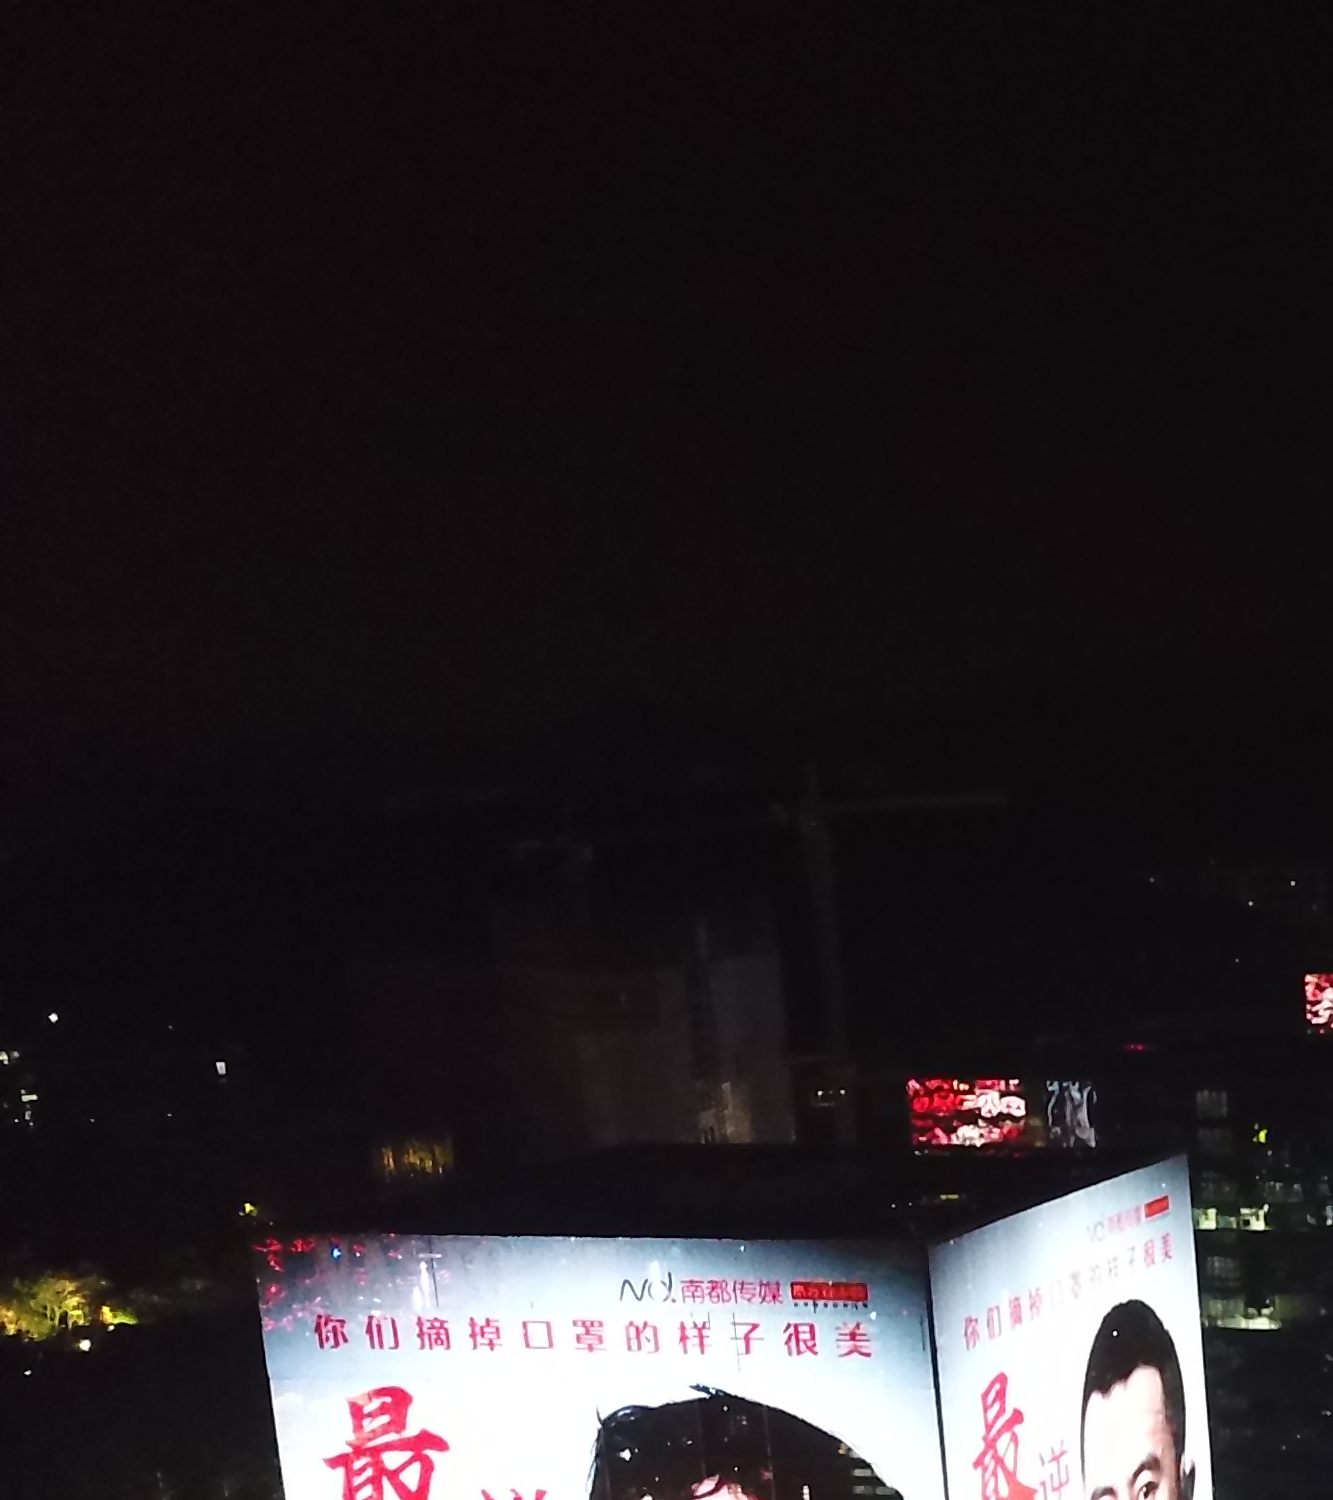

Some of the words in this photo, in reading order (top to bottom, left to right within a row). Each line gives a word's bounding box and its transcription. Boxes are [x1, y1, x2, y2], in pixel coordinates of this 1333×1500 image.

[680, 1279, 783, 1304] 南都传媒
[313, 1304, 872, 1358] 你们摘掉口罩的样子很美
